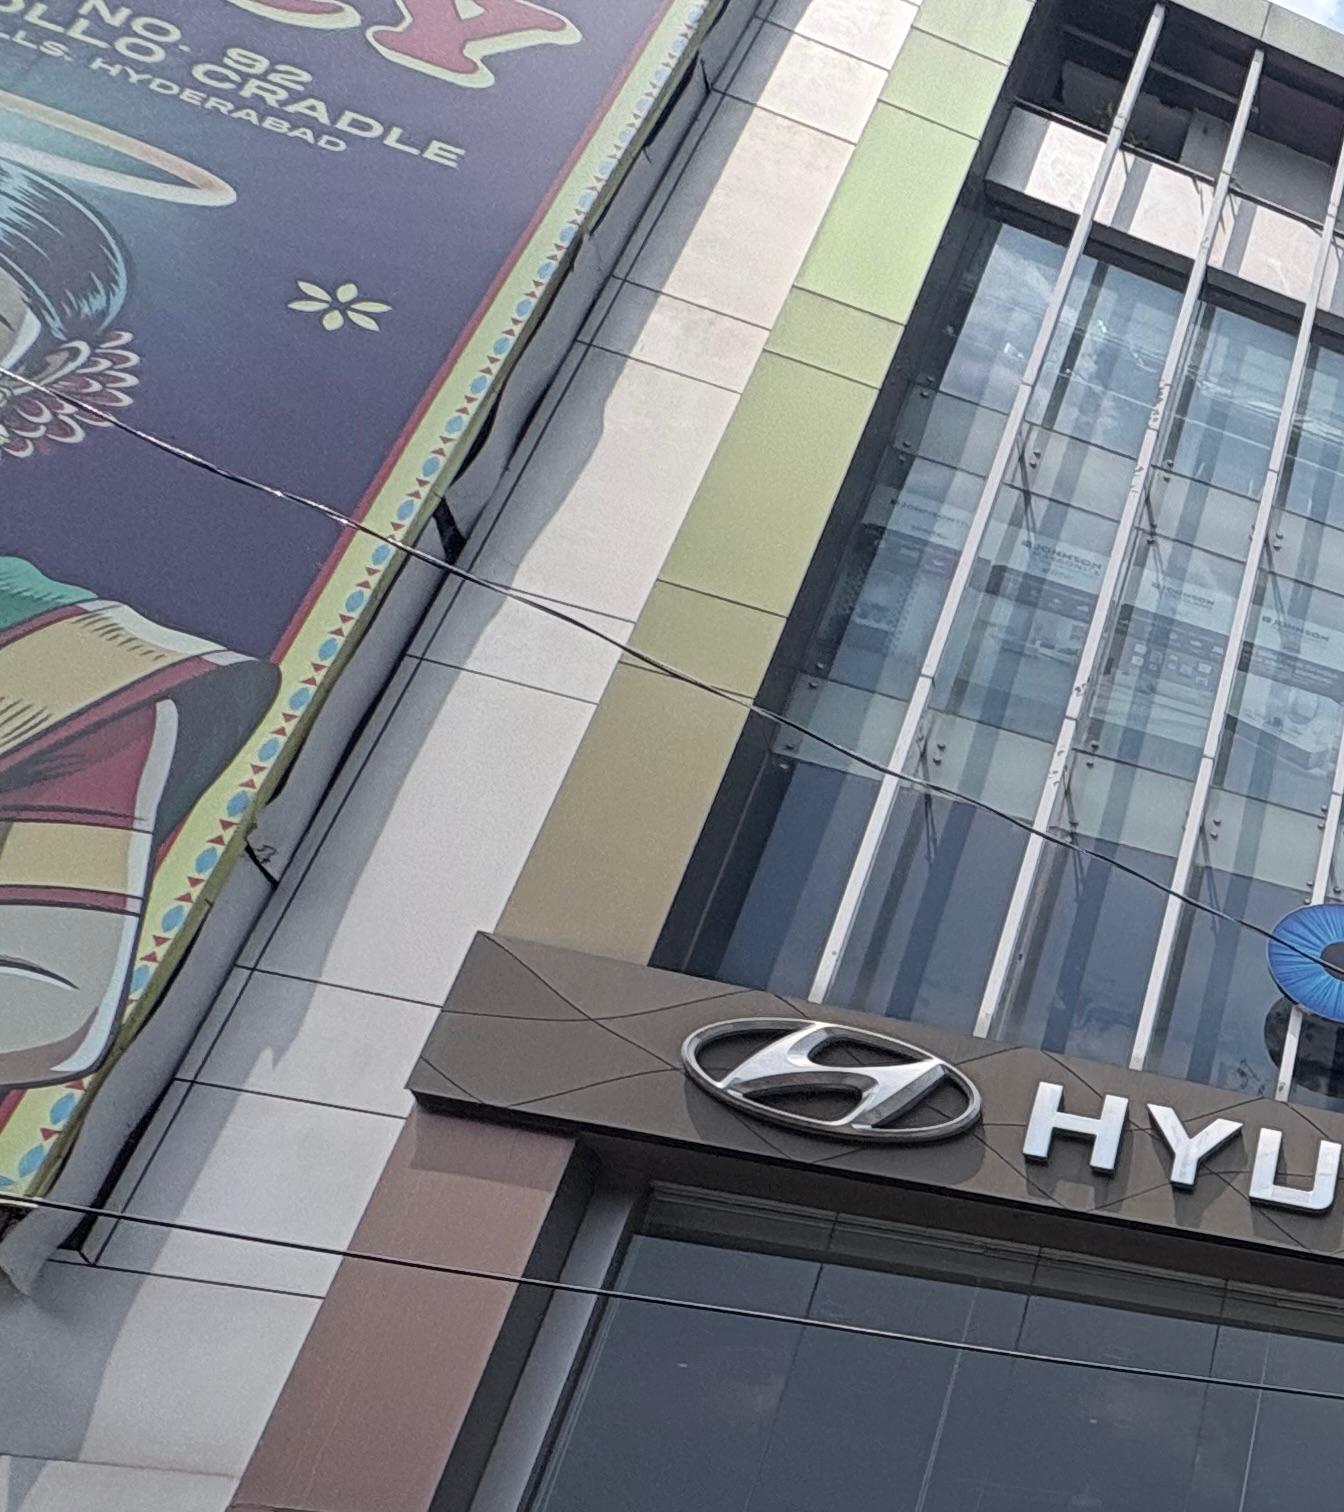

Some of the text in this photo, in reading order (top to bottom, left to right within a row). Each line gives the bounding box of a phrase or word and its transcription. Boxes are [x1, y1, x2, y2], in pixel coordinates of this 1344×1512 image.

[89, 57, 348, 152] HYDERABAD
[191, 62, 467, 170] CRADLE
[224, 46, 314, 91] 92
